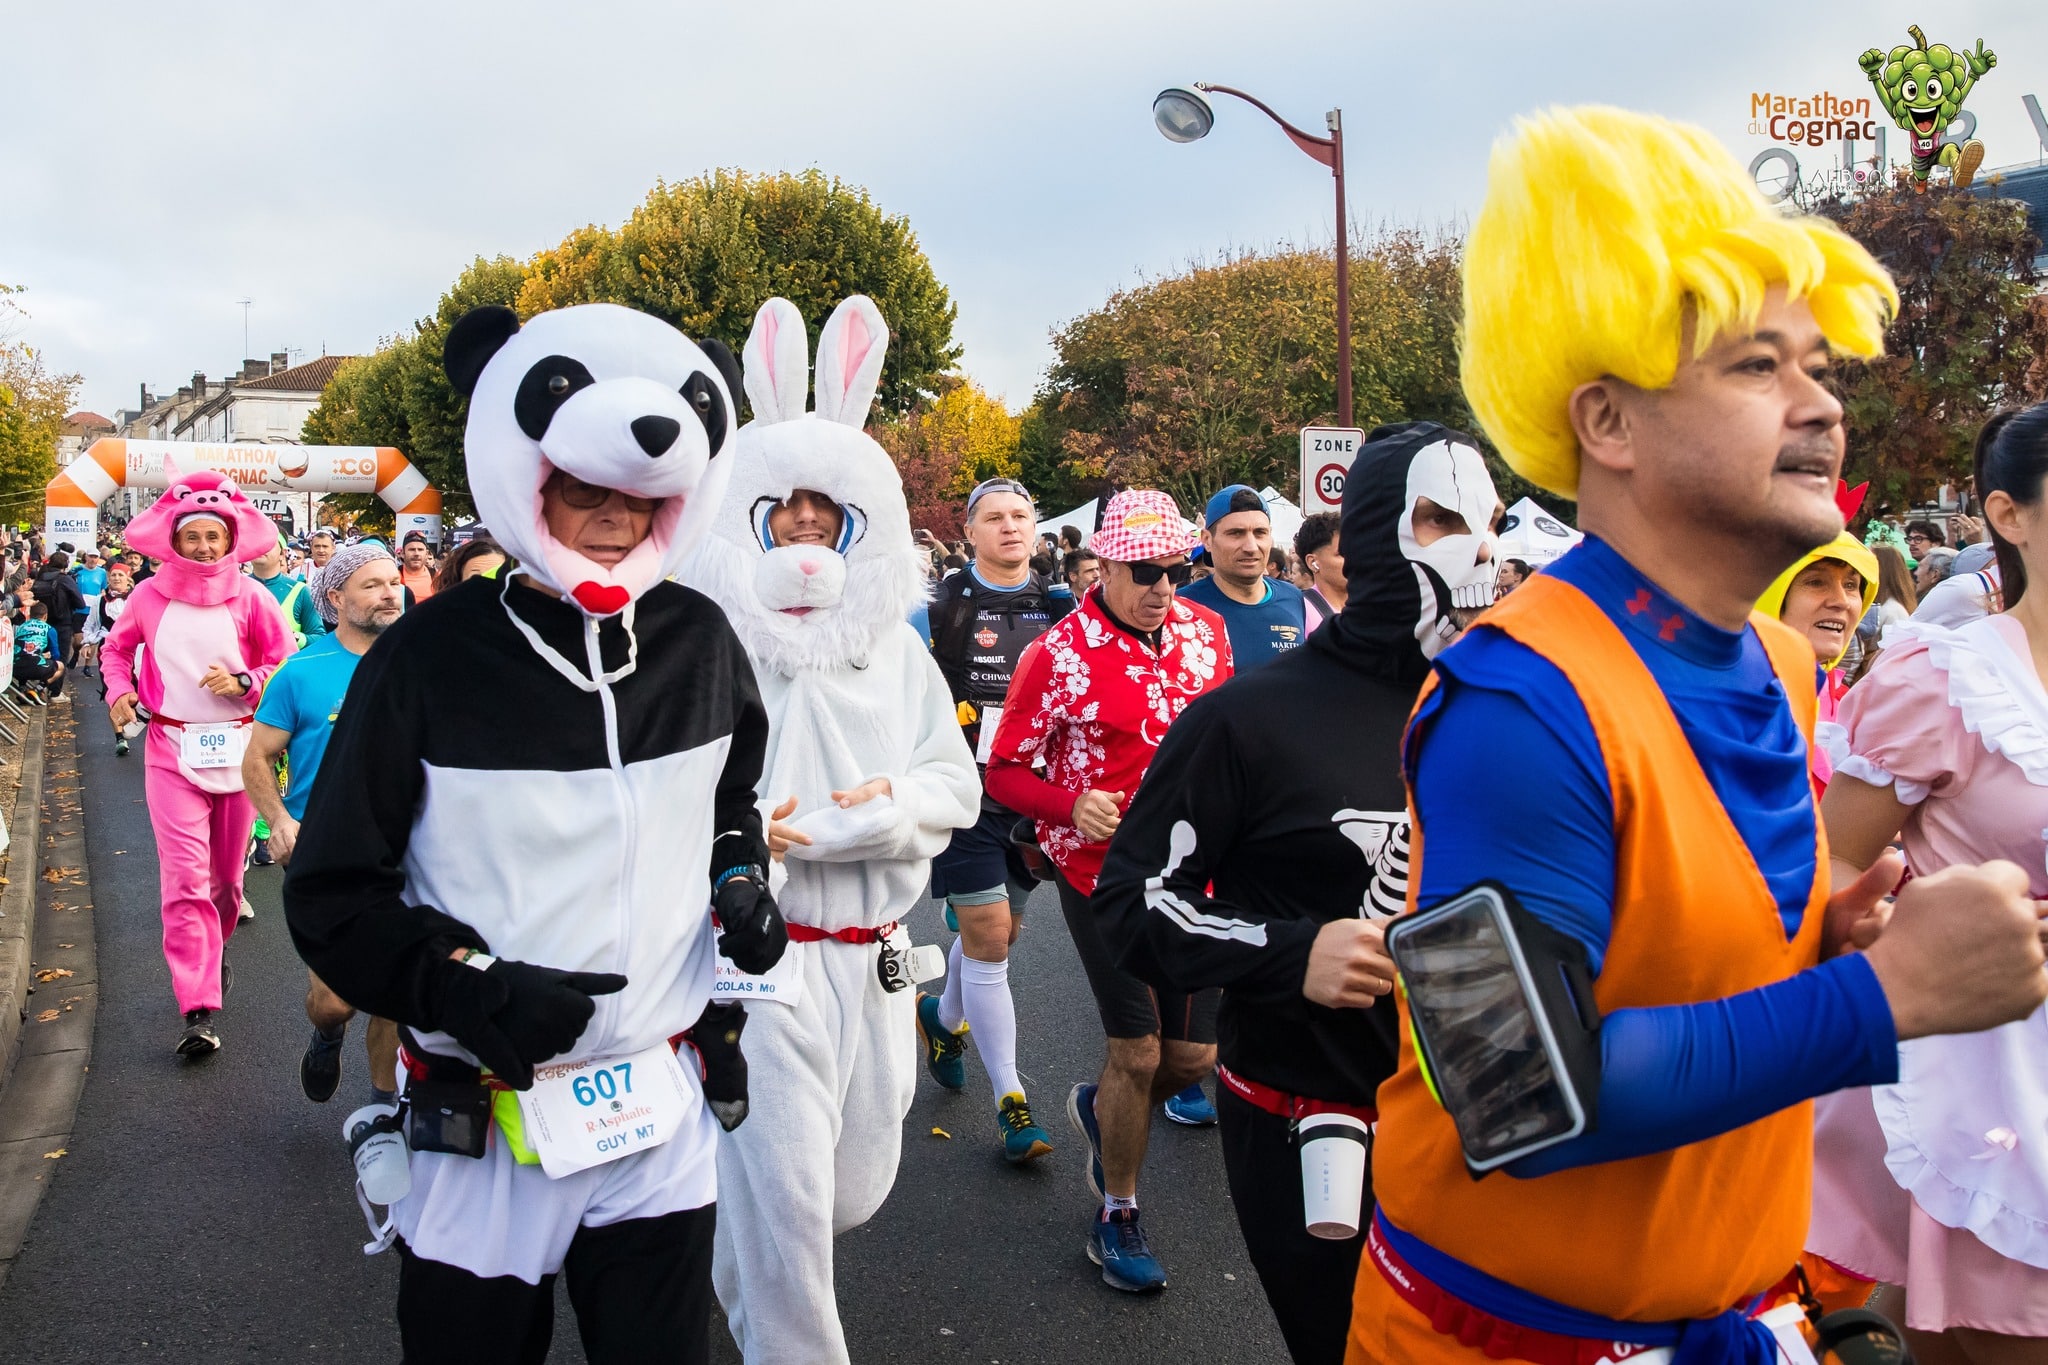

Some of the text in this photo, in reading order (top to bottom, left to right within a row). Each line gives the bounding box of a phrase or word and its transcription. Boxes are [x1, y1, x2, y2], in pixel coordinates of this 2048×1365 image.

[1314, 439, 1353, 452] ZONE
[194, 446, 277, 465] MARATHON
[1322, 475, 1345, 493] 30
[54, 519, 90, 527] BACHE
[973, 655, 1006, 664] ABSOLUT.
[981, 673, 1011, 681] CHIVAS
[200, 734, 225, 747] 609
[713, 981, 753, 992] COLAS
[571, 1062, 633, 1107] 607
[596, 1123, 656, 1153] GUY M7
